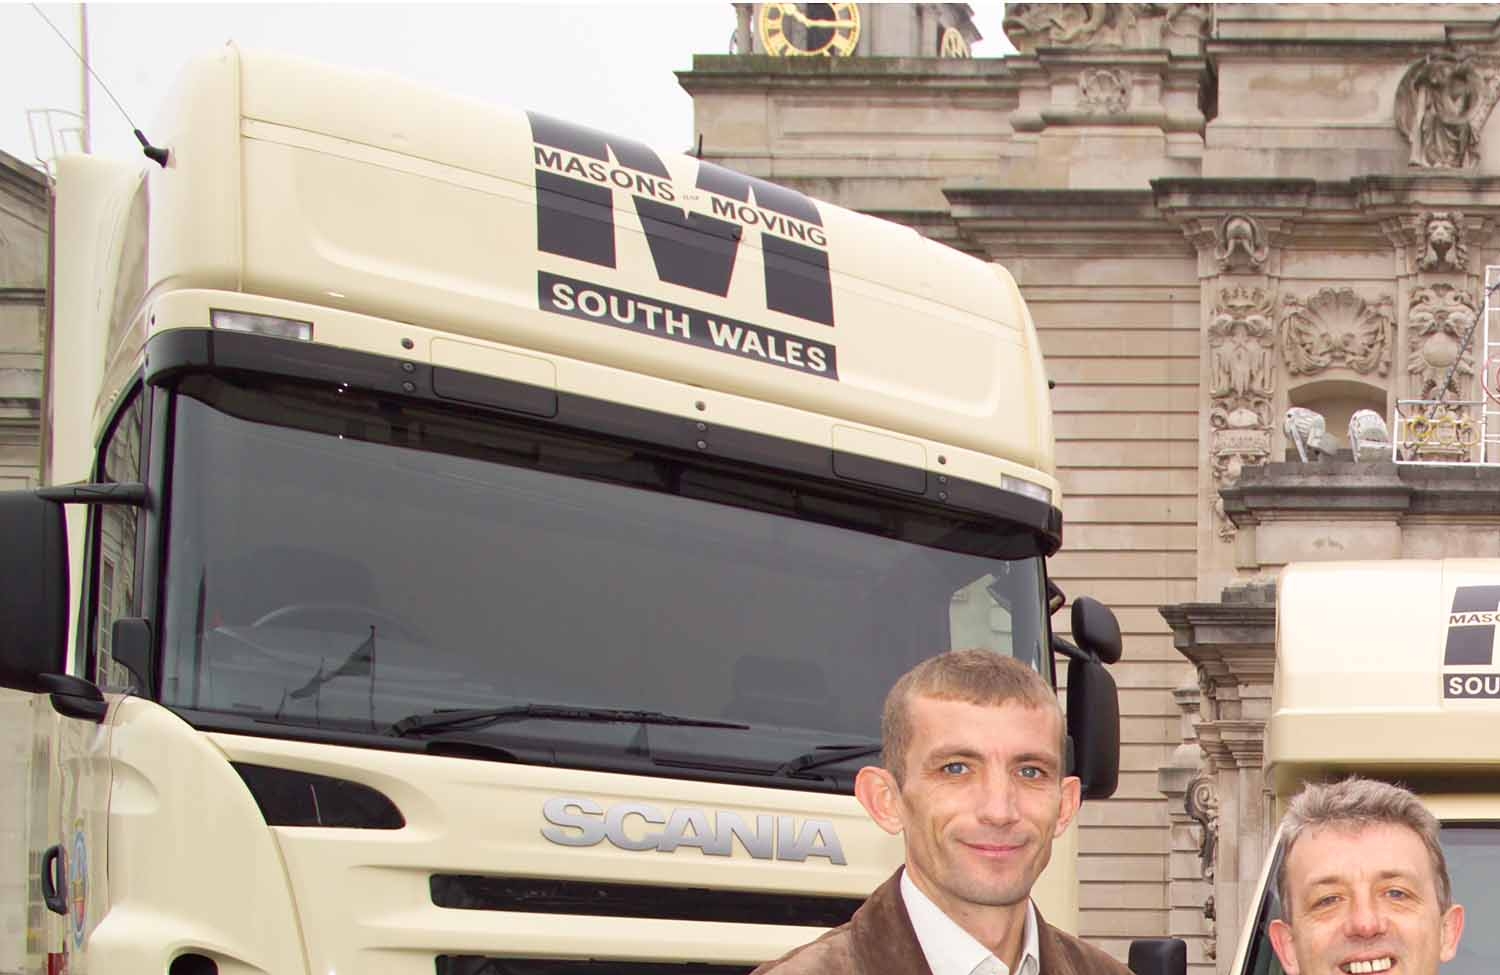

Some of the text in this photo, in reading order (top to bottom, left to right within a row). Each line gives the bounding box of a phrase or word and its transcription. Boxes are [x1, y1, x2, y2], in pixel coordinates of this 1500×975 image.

[534, 145, 827, 247] MASONS MOVING
[551, 282, 827, 372] SOUTH WALES
[540, 796, 848, 866] SCANIA
